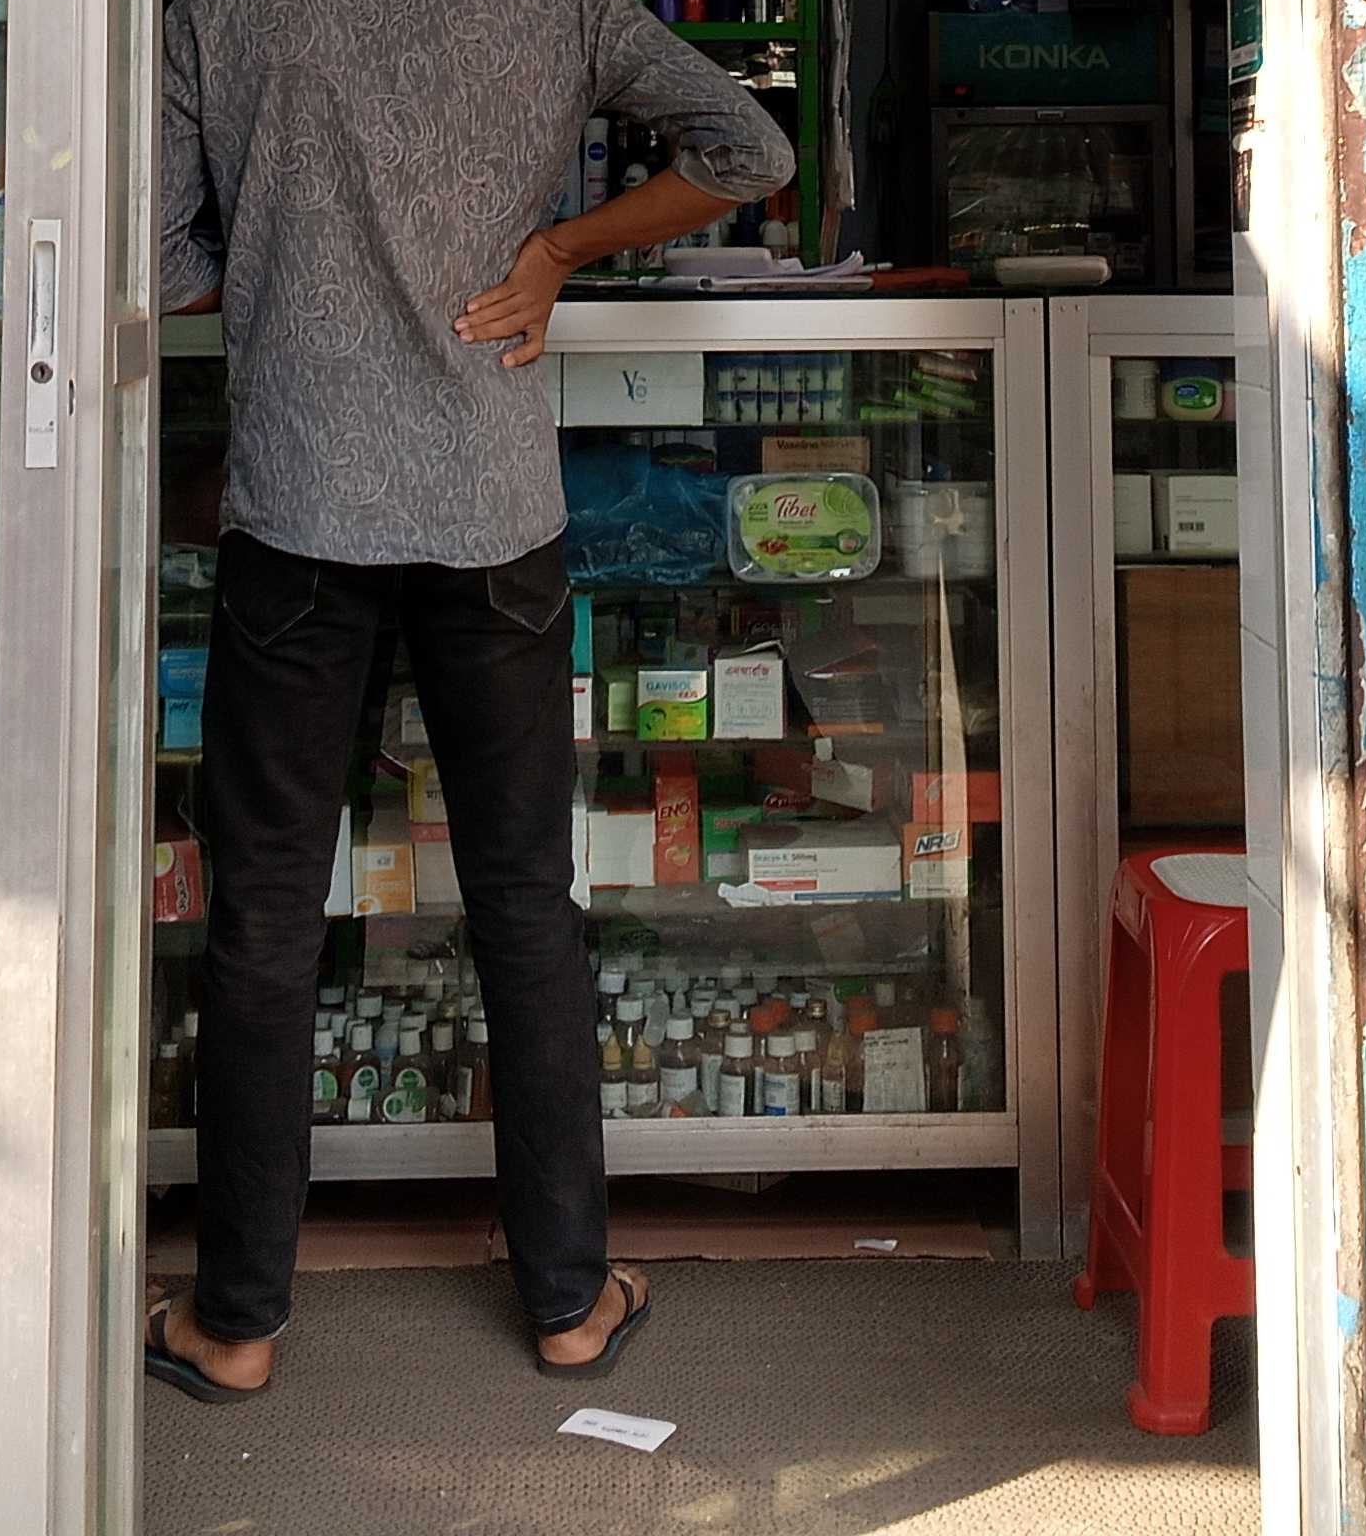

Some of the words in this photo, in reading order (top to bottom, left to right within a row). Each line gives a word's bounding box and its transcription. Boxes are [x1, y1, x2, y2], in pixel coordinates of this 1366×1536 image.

[978, 43, 1111, 72] KONKA
[774, 493, 818, 519] Tibet
[659, 801, 691, 819] ENO
